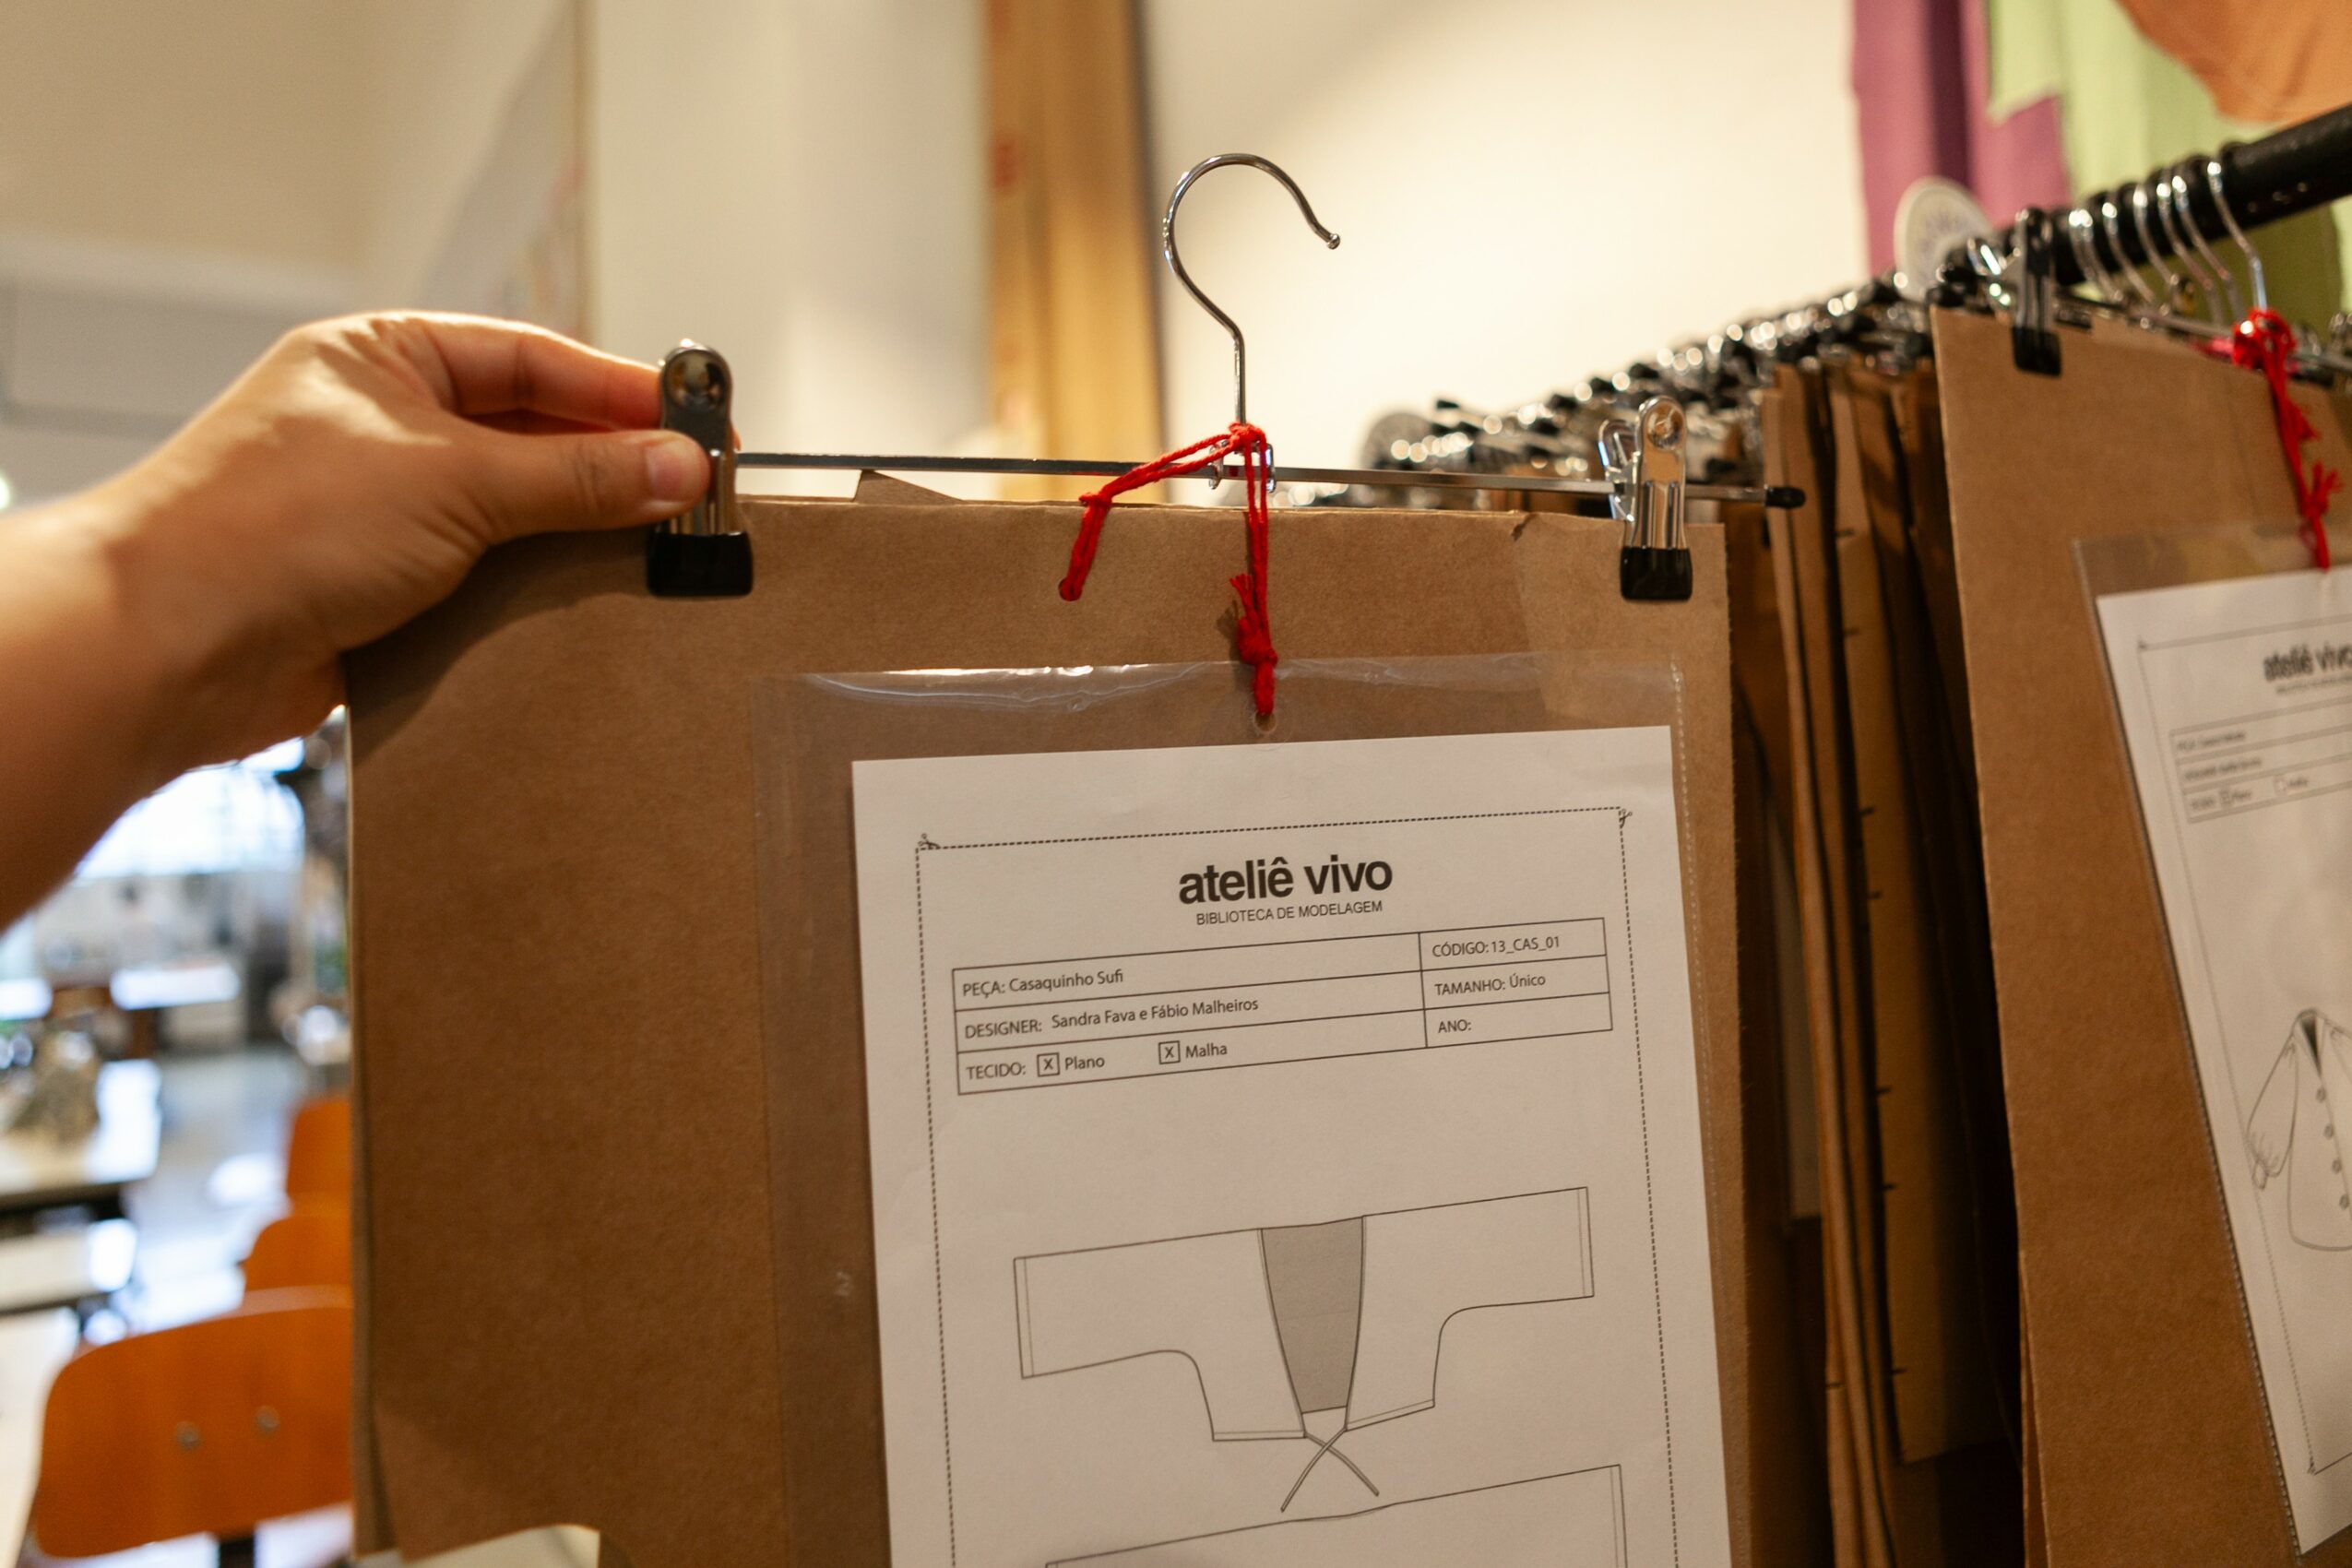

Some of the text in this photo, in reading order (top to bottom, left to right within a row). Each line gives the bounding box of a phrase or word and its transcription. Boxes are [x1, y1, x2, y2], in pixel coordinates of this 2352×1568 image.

[1179, 854, 1393, 904] ateliê vivo
[1196, 900, 1383, 925] BIBLIOTECA DE MODELAGEM
[1432, 936, 1560, 957] CÓDIGO: 13_CAS_01
[963, 968, 1123, 999] PEÇA: Casaquinho Sufi
[1434, 972, 1546, 995] TAMANHO: Único
[965, 999, 1259, 1039] DESIGNER: Sandra Fava e Fábio Malheiros
[1438, 1019, 1471, 1033] ANO:
[967, 1062, 1027, 1080] TECIDO:
[1064, 1055, 1105, 1071] Plano
[1185, 1043, 1228, 1059] Malha
